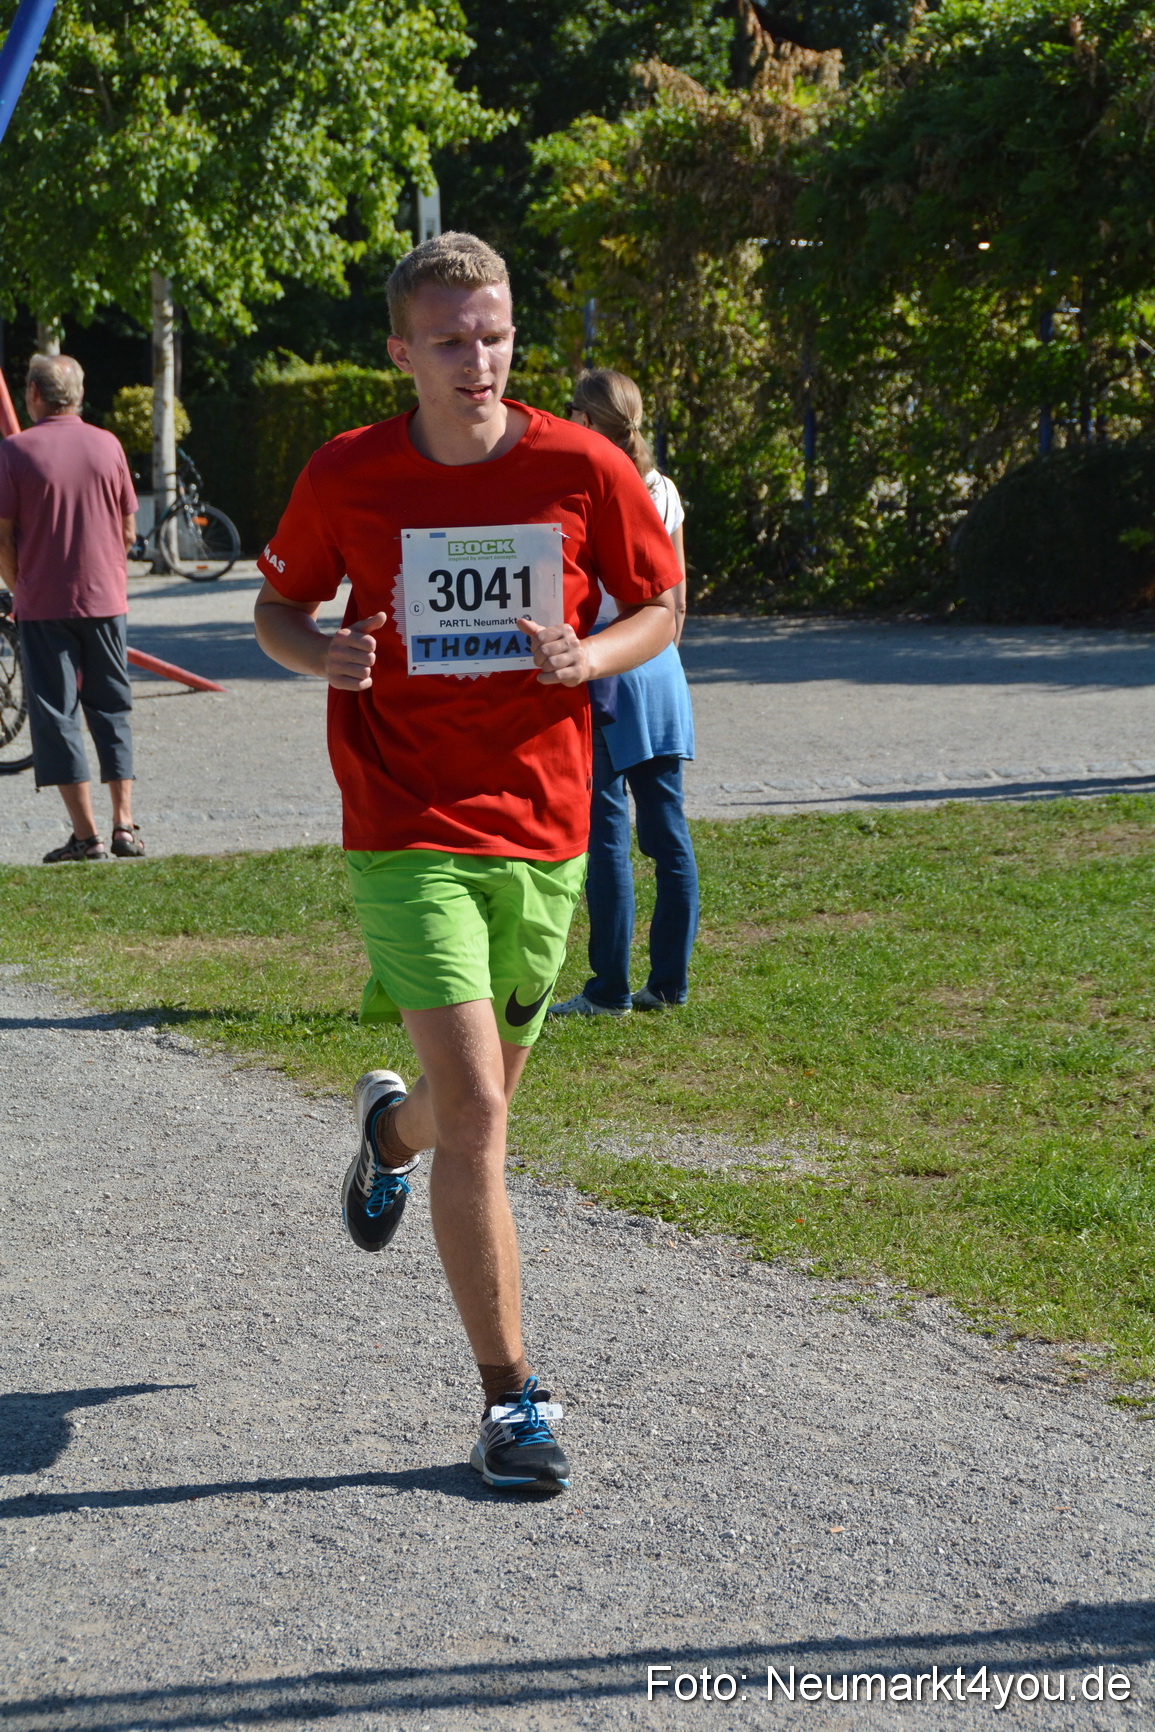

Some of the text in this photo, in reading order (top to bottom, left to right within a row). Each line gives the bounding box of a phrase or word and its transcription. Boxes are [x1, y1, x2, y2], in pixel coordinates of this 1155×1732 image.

[448, 539, 516, 555] BOCK
[428, 566, 531, 613] 3041
[414, 604, 420, 612] C
[439, 616, 518, 628] PARTL Neumarkt
